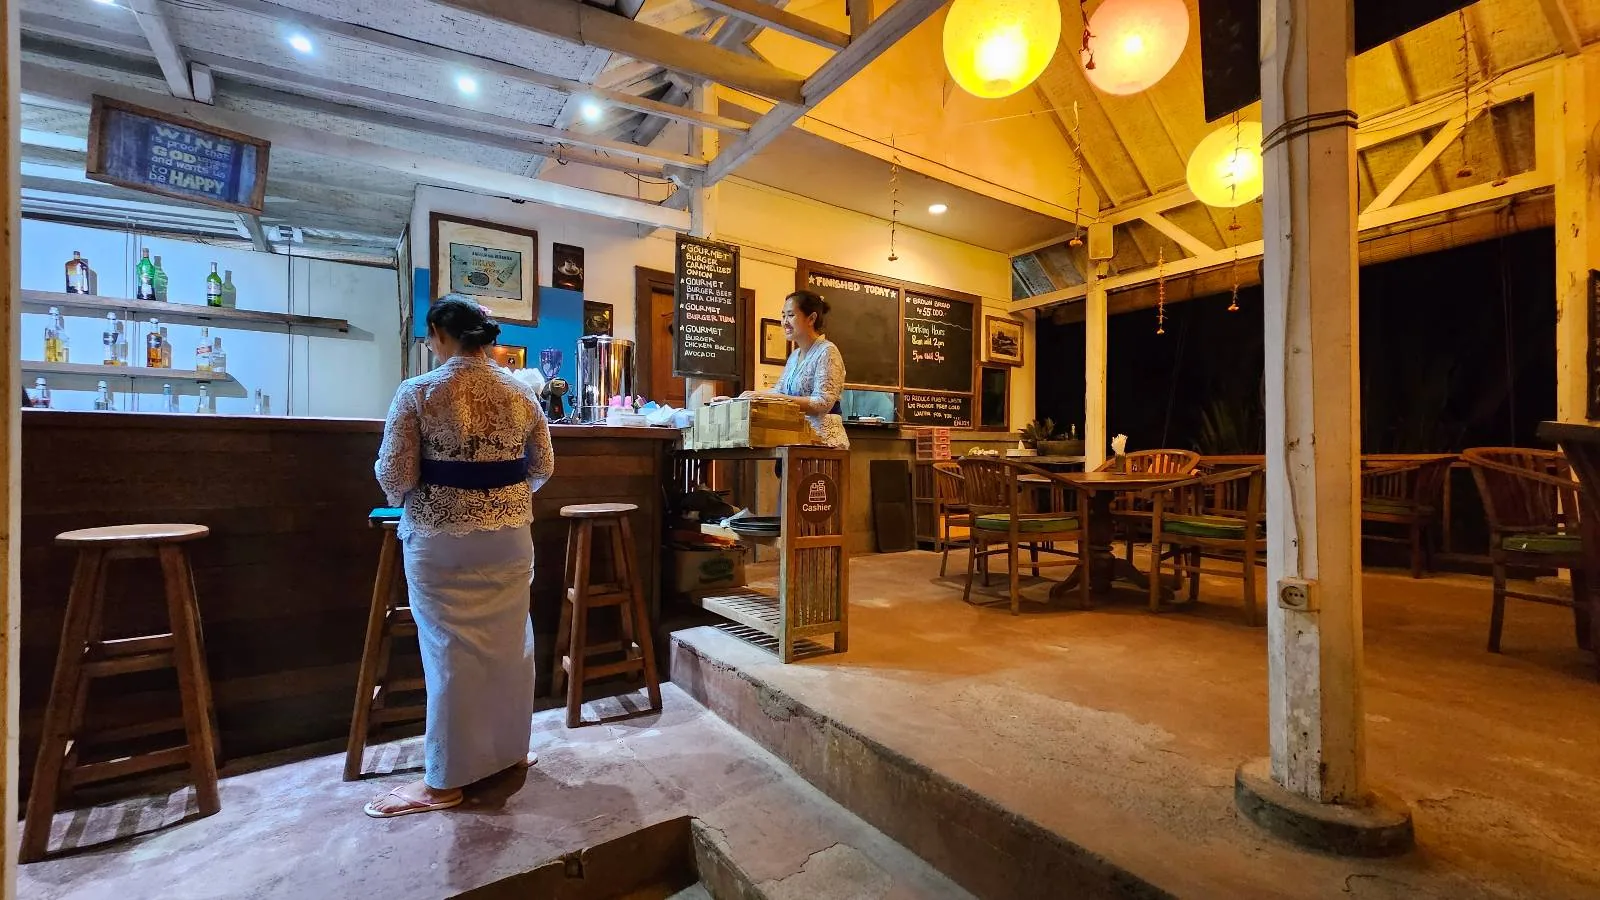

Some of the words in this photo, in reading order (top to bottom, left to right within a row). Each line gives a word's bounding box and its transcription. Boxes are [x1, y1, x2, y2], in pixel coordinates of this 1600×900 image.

[155, 126, 231, 154] WINE
[151, 135, 162, 143] is
[167, 140, 199, 152] proof
[205, 149, 231, 160] that
[152, 145, 197, 164] GOD
[151, 155, 173, 166] and
[176, 161, 209, 174] wants
[152, 164, 168, 175] to
[149, 171, 166, 183] be
[169, 169, 225, 195] HAPPY
[686, 244, 729, 260] GOURMET
[686, 253, 718, 266] BURGER
[685, 261, 732, 275] CARAMELIZED
[686, 269, 713, 279] ONION
[685, 277, 724, 289] GOURMET
[815, 276, 861, 292] FINISHED
[864, 285, 890, 298] TODAY
[686, 285, 714, 295] BURGER
[716, 287, 732, 297] BEEF
[686, 293, 704, 302] FETA
[705, 295, 732, 305] CHEESE
[912, 298, 933, 306] BROWN
[685, 302, 721, 315] GOURMET
[686, 312, 718, 322] BURGER
[718, 316, 736, 324] TUNA
[685, 324, 723, 336] GOURMET
[906, 323, 930, 338] Working
[931, 324, 946, 336] Hours
[685, 333, 715, 343] BURGER
[684, 341, 712, 349] CHICKEN
[714, 344, 735, 352] BACON
[684, 350, 716, 358] AVOCADO
[911, 394, 931, 402] REDUCE
[802, 503, 832, 512] Cashier
